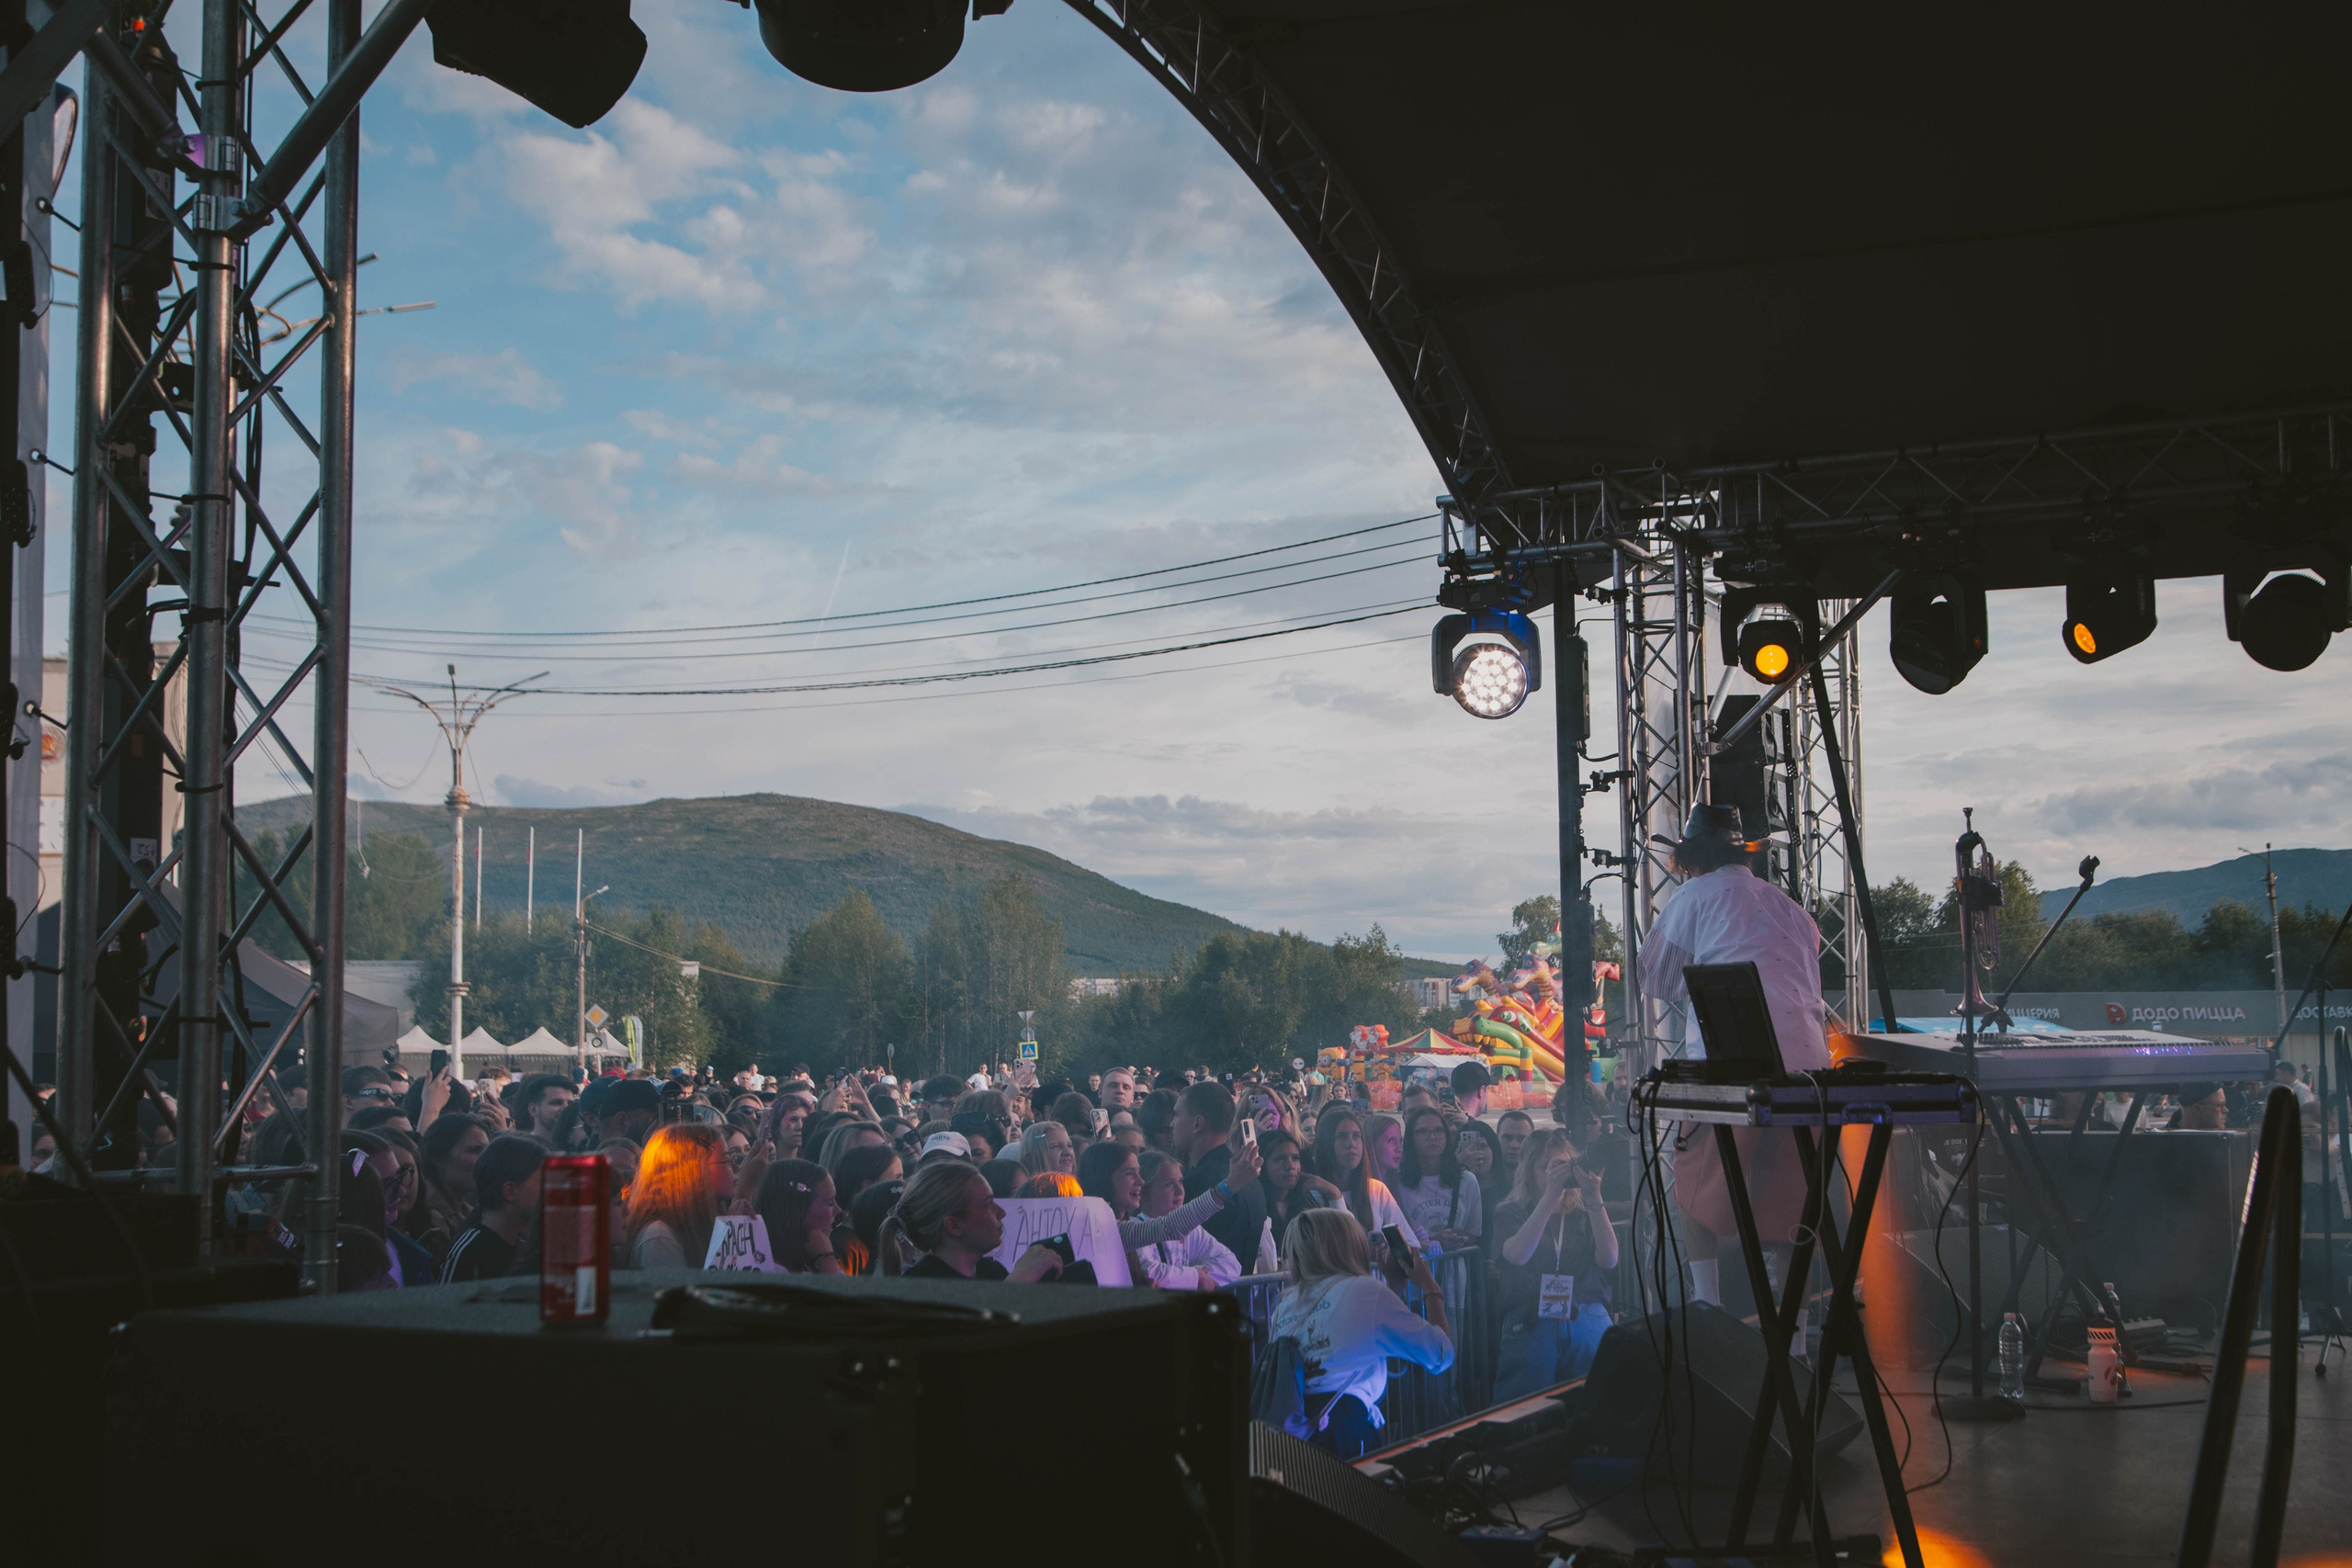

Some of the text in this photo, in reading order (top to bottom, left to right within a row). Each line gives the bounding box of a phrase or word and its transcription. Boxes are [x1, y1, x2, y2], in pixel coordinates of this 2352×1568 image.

[2003, 1007, 2061, 1020] ИЦЦЕРИЯ
[2132, 1007, 2248, 1022] ДОДО ПИЦЦА
[1410, 1198, 1442, 1221] BETTER
